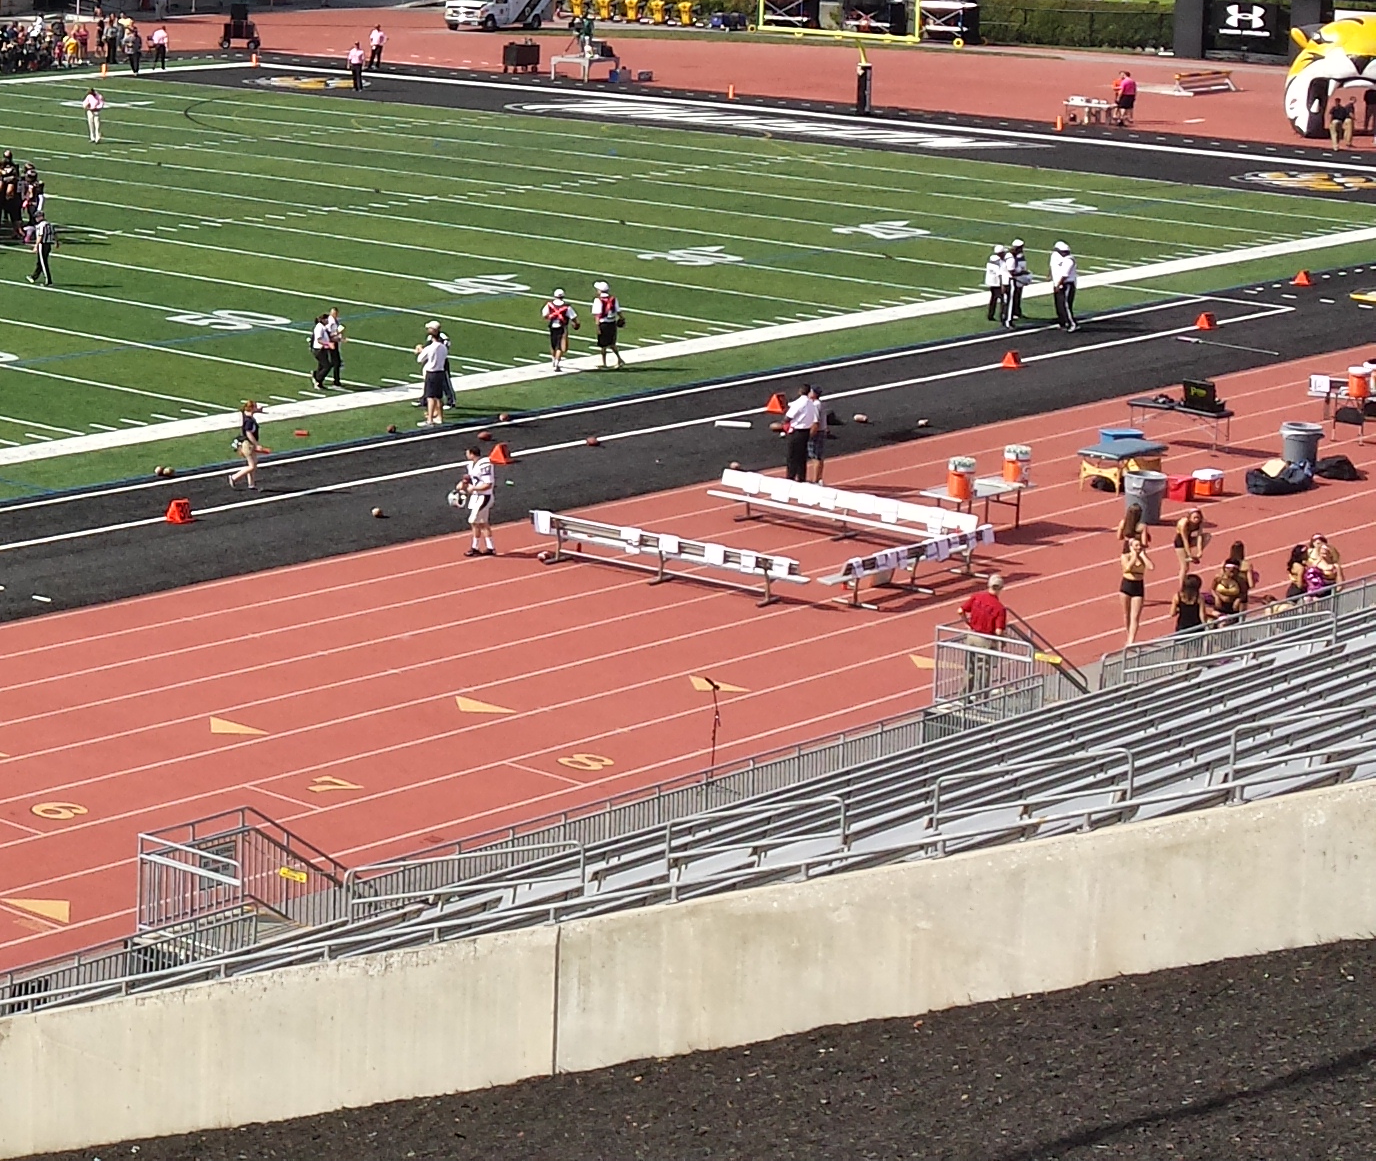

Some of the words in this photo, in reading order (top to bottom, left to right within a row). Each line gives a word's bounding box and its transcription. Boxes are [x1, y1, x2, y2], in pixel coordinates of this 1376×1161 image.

[165, 309, 292, 331] 50
[557, 753, 615, 771] 8
[307, 775, 365, 793] 7
[31, 801, 89, 820] 6
